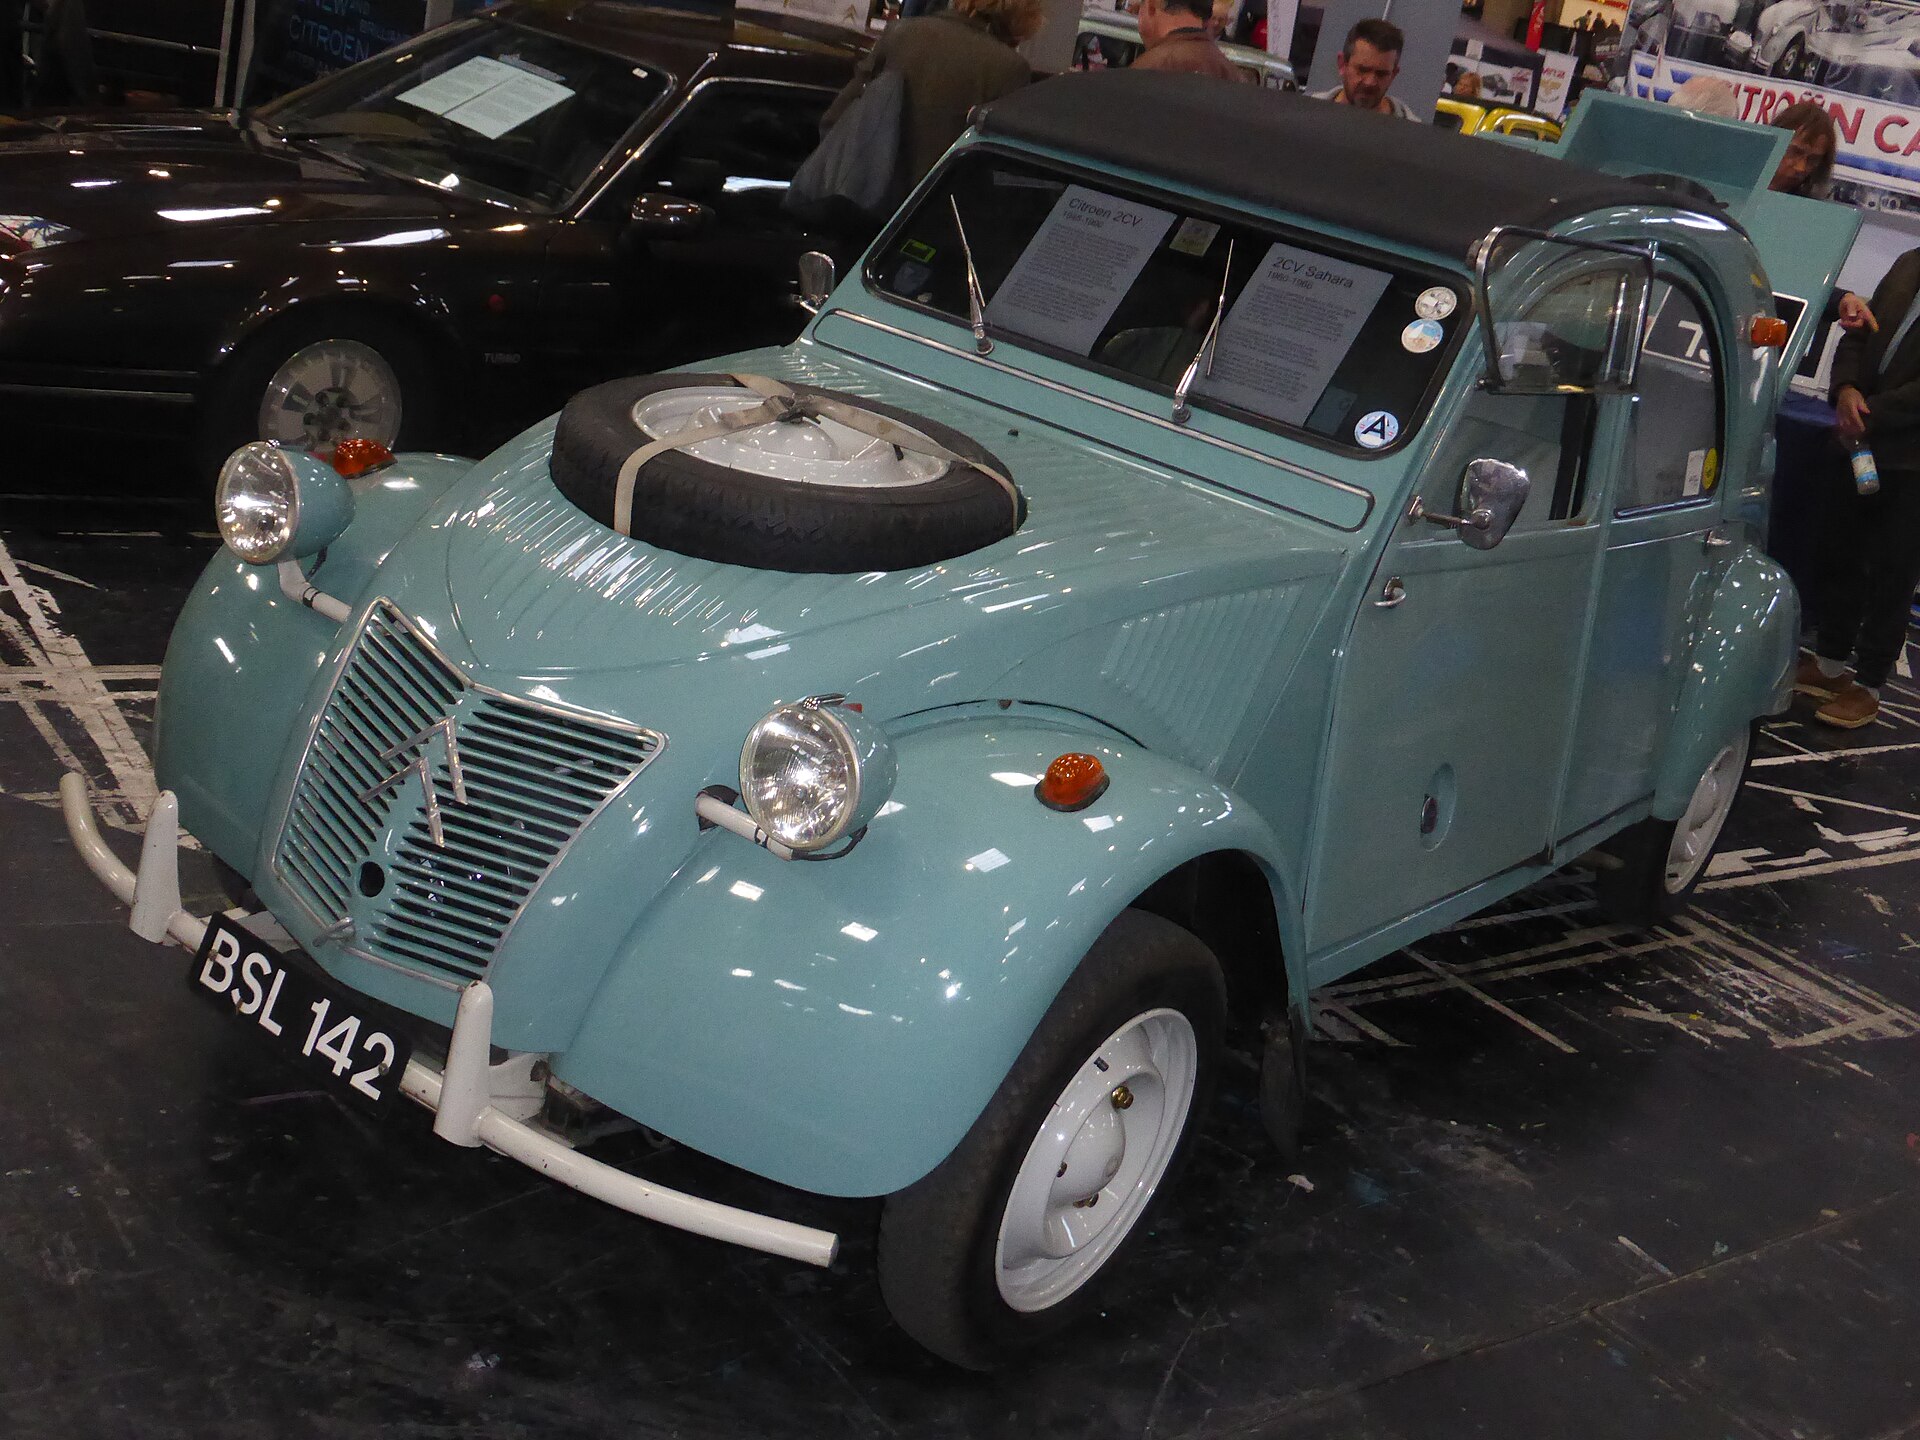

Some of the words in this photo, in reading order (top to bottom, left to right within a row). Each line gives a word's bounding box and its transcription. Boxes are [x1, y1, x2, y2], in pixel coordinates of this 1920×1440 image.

[1728, 82, 1866, 144] TRON
[1069, 198, 1112, 219] Citroen
[1113, 210, 1143, 228] 2CV
[1273, 256, 1305, 273] 2CV
[1305, 265, 1353, 288] Sahara
[199, 927, 286, 1037] BSL
[302, 998, 395, 1101] 142
